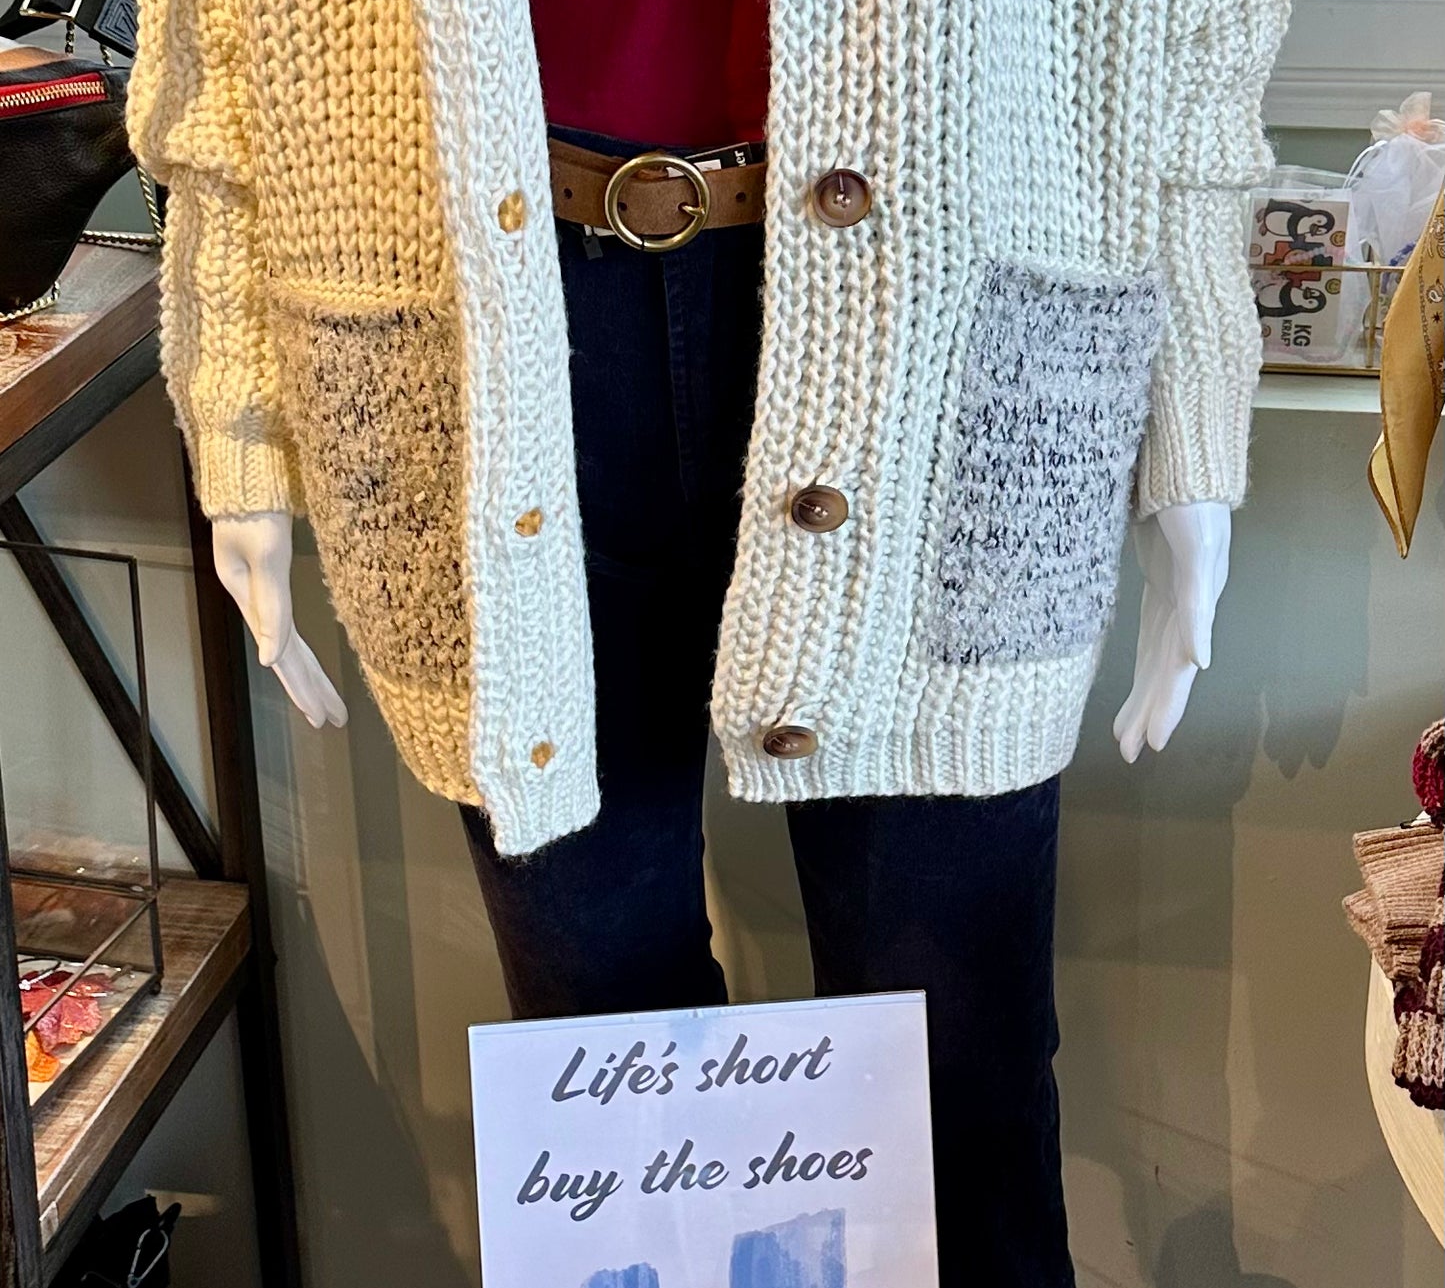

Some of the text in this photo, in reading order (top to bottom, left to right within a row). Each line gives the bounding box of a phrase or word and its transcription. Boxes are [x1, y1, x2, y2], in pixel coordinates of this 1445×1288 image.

[734, 150, 747, 167] er
[1293, 324, 1312, 347] KG
[551, 1033, 834, 1105] Life's short
[516, 1131, 874, 1221] buy the shoes
